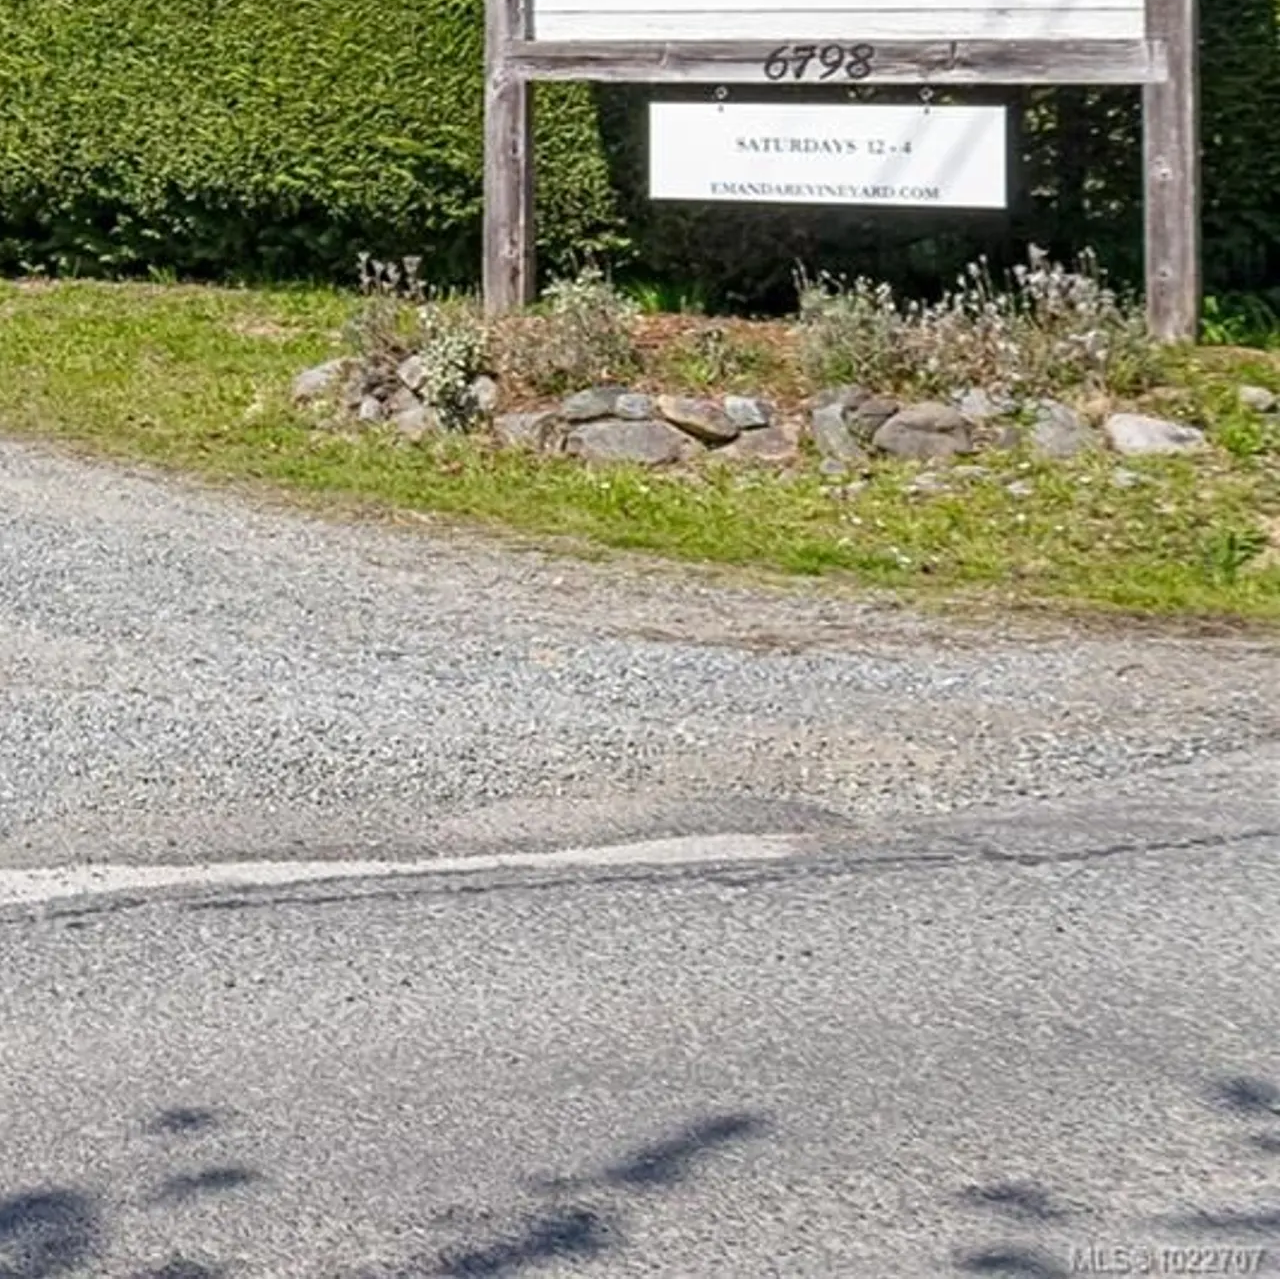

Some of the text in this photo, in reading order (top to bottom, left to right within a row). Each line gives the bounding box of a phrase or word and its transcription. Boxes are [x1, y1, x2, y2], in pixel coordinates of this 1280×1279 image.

[764, 43, 874, 80] 6798
[736, 136, 858, 154] SATURDAYS
[867, 140, 885, 155] 12
[900, 141, 913, 154] 4
[710, 181, 940, 199] EMANDAREVINEYARD.COM
